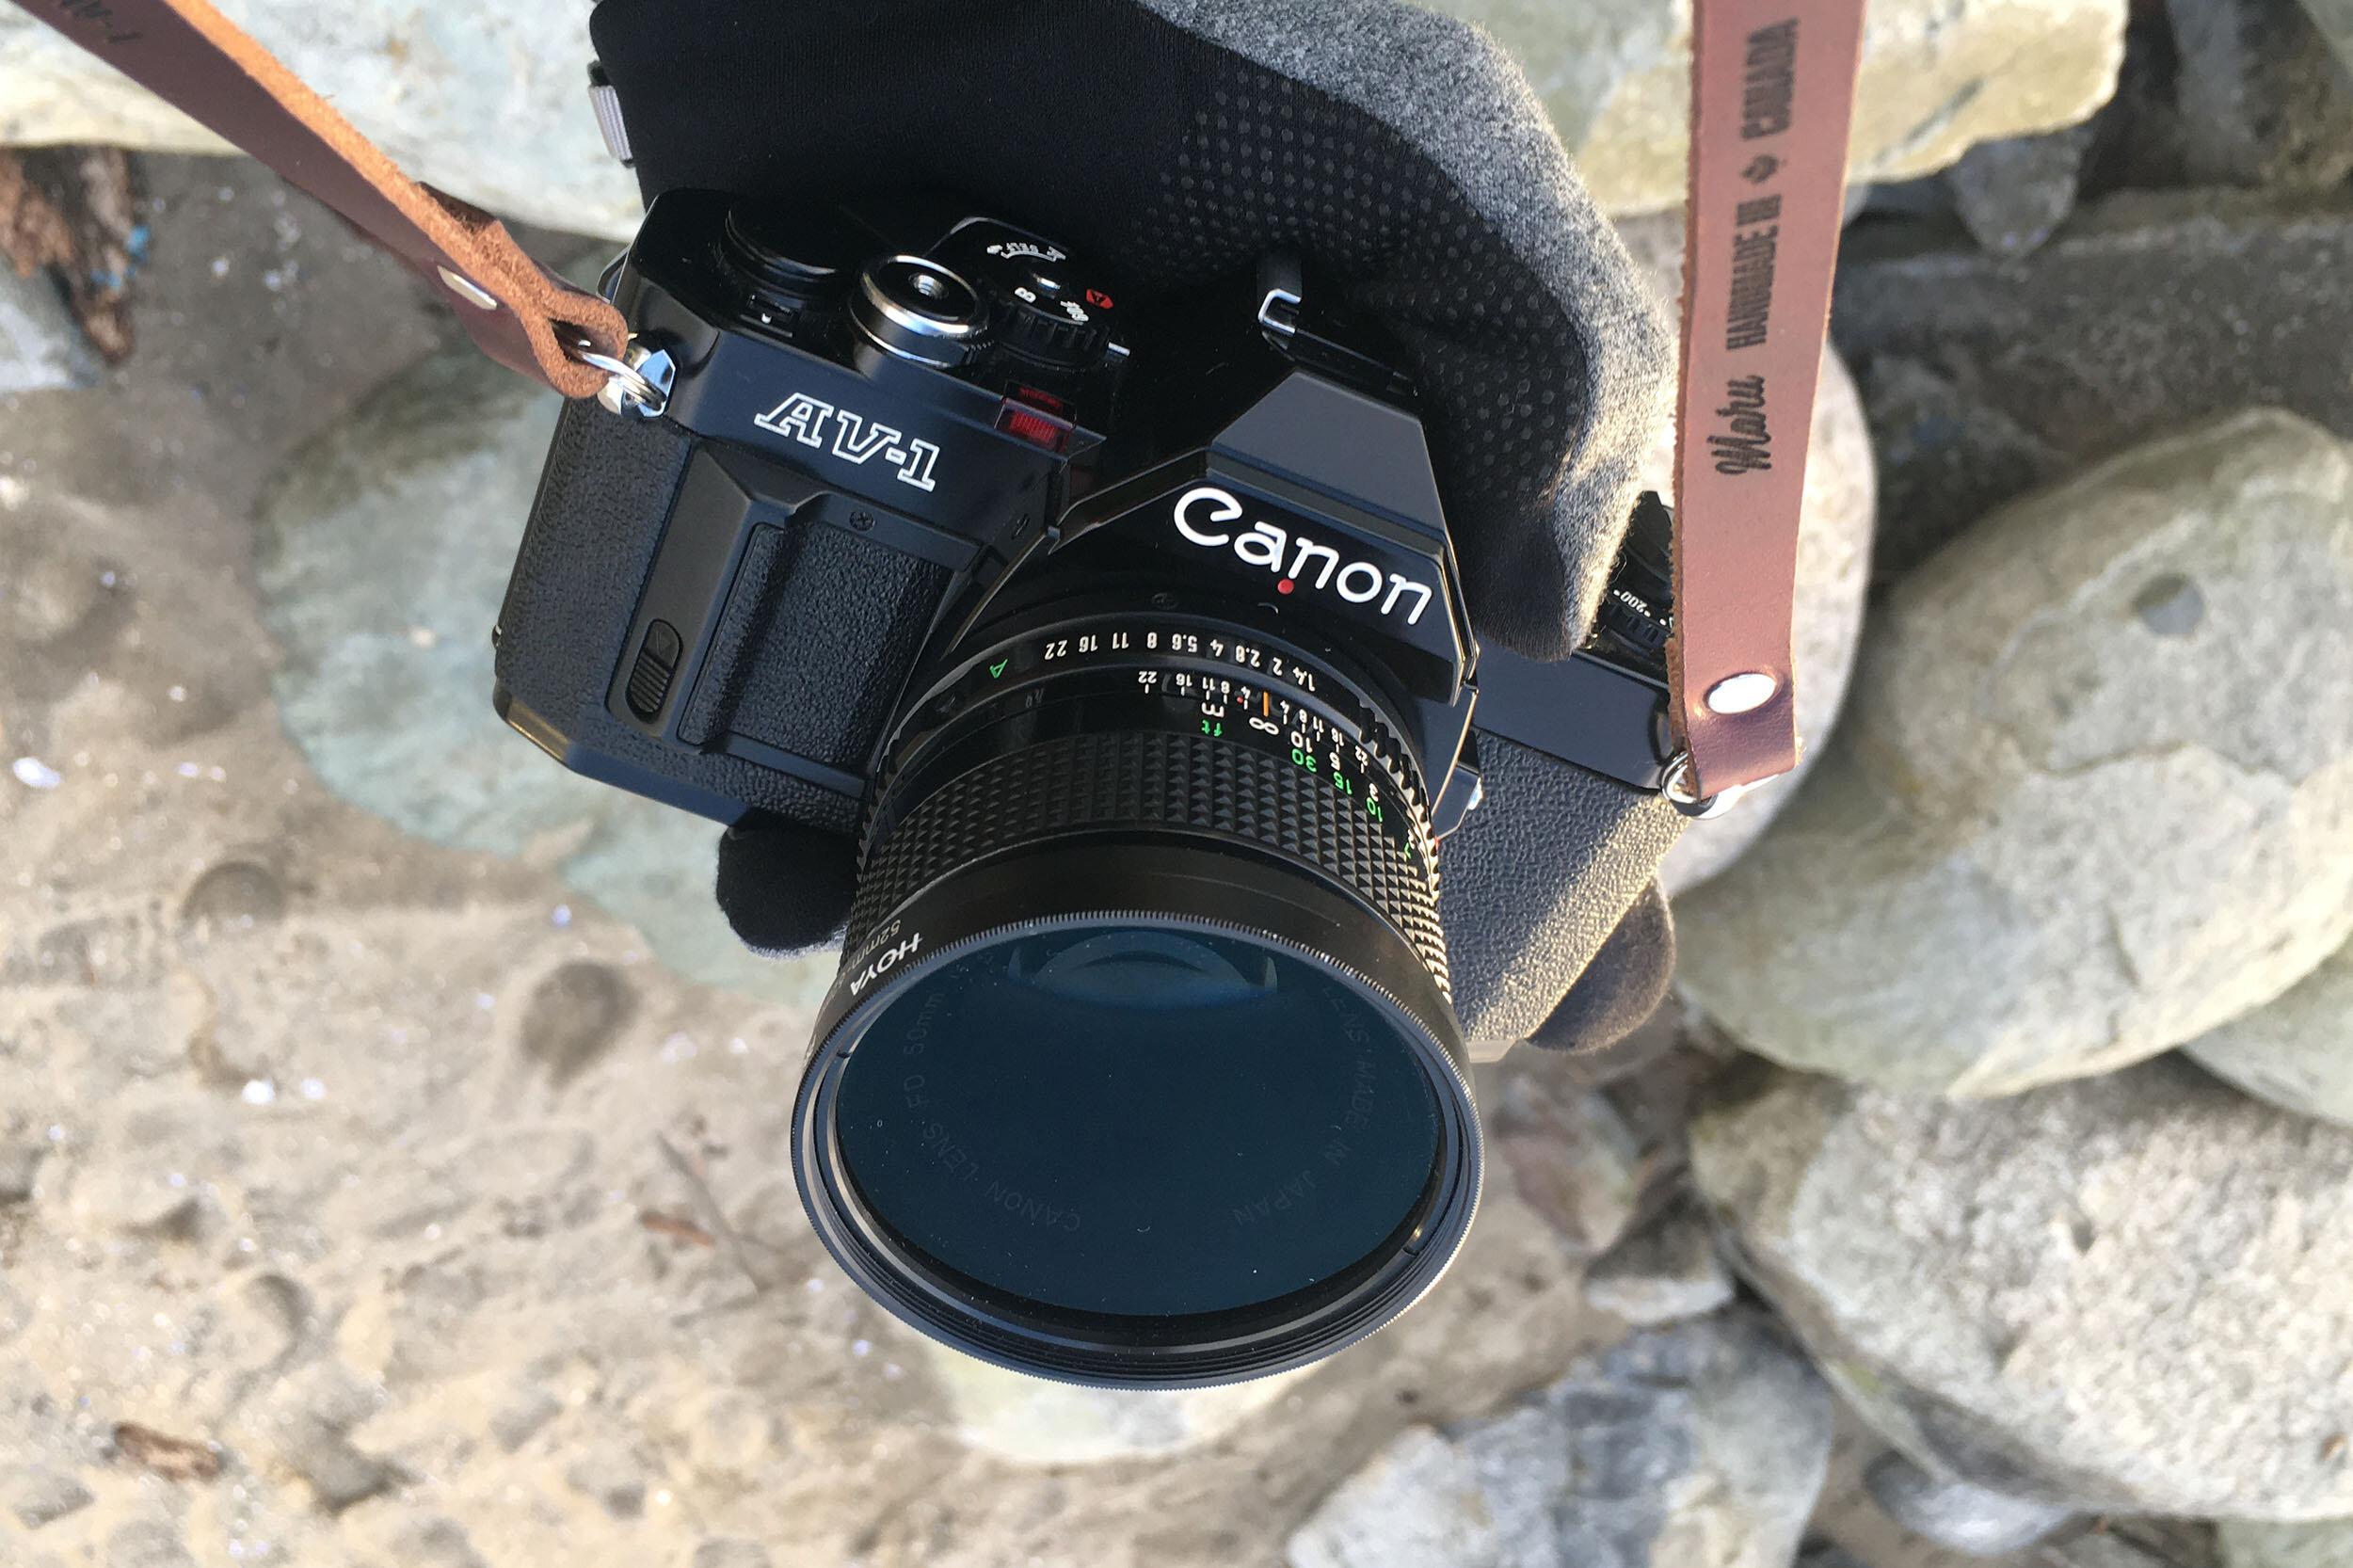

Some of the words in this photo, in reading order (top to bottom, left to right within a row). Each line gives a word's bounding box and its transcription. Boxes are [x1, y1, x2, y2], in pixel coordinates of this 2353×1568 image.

[1741, 17, 1799, 139] CANADA
[1736, 193, 1782, 227] IN
[1725, 223, 1779, 350] HANDMADE
[754, 392, 940, 492] AV-1
[1174, 487, 1433, 625] Canon
[1045, 640, 1068, 661] 22
[1079, 634, 1098, 653] 16
[1112, 632, 1129, 649] 11
[1146, 632, 1158, 649] 8
[1171, 633, 1198, 653] 5.6
[1209, 639, 1224, 657] 4
[1235, 645, 1261, 667] 2.8
[1273, 657, 1283, 676] 2
[989, 658, 1009, 680] A
[1138, 670, 1158, 683] 22
[1176, 673, 1193, 687] 16
[1202, 676, 1215, 691] 11
[1290, 730, 1314, 753] 10
[1291, 748, 1317, 772] 30
[1333, 771, 1353, 794] 15
[1367, 797, 1384, 823] 10
[850, 932, 923, 996] HOYA
[923, 1122, 980, 1181] LENS
[984, 1179, 1081, 1232] CANON
[1232, 1169, 1318, 1226] JAPAN
